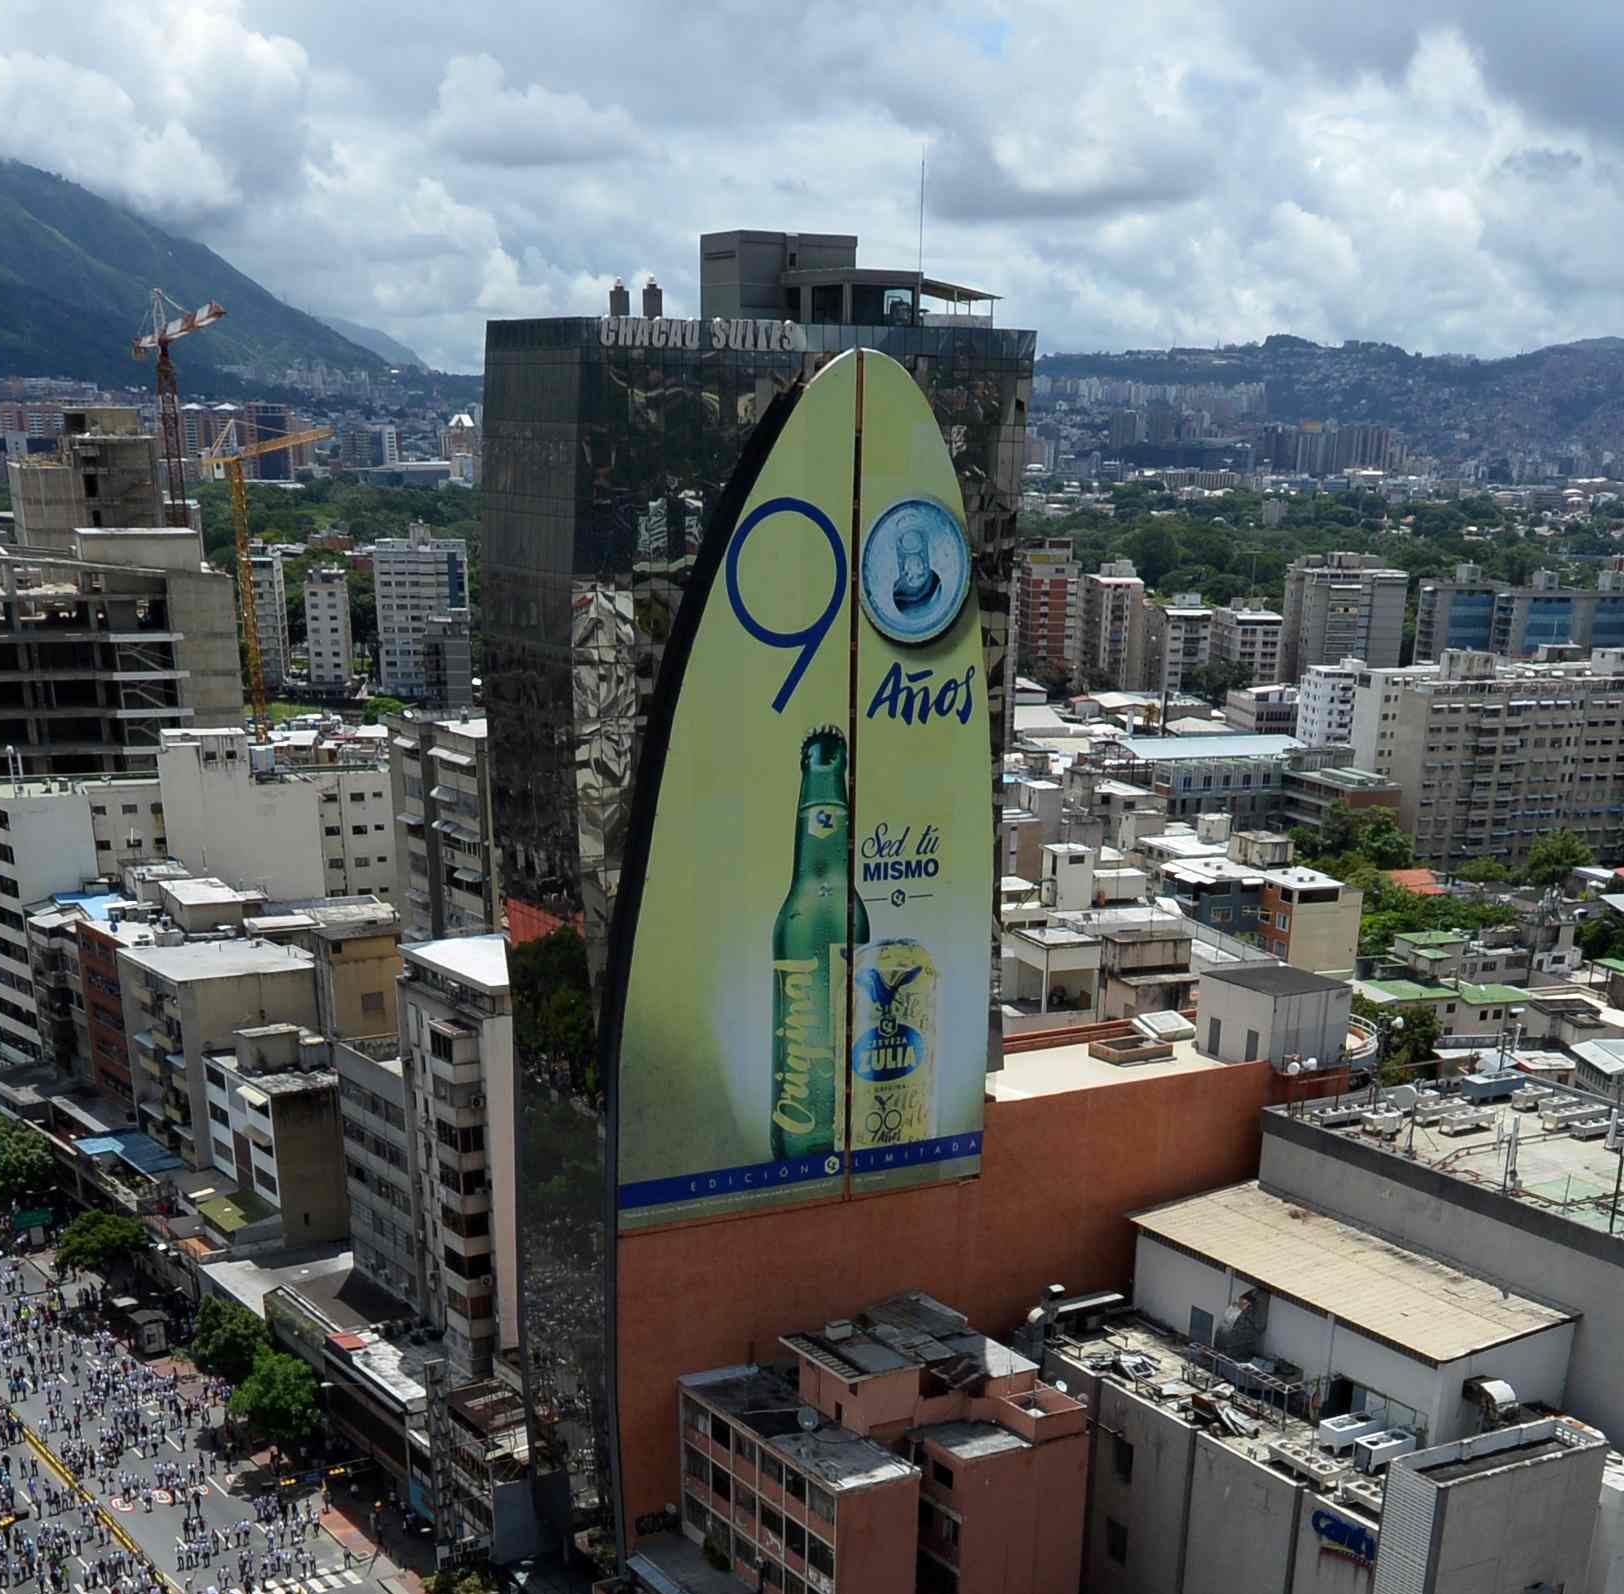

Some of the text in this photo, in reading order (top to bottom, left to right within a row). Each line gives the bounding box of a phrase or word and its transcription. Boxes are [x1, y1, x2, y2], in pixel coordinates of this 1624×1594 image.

[867, 661, 976, 725] Años
[861, 822, 910, 859] Sed
[863, 858, 939, 882] MISMO
[773, 959, 833, 1134] Original
[860, 1046, 916, 1072] ZULIA
[855, 1139, 977, 1168] LIMITADA
[690, 1163, 809, 1192] EDICIÓN
